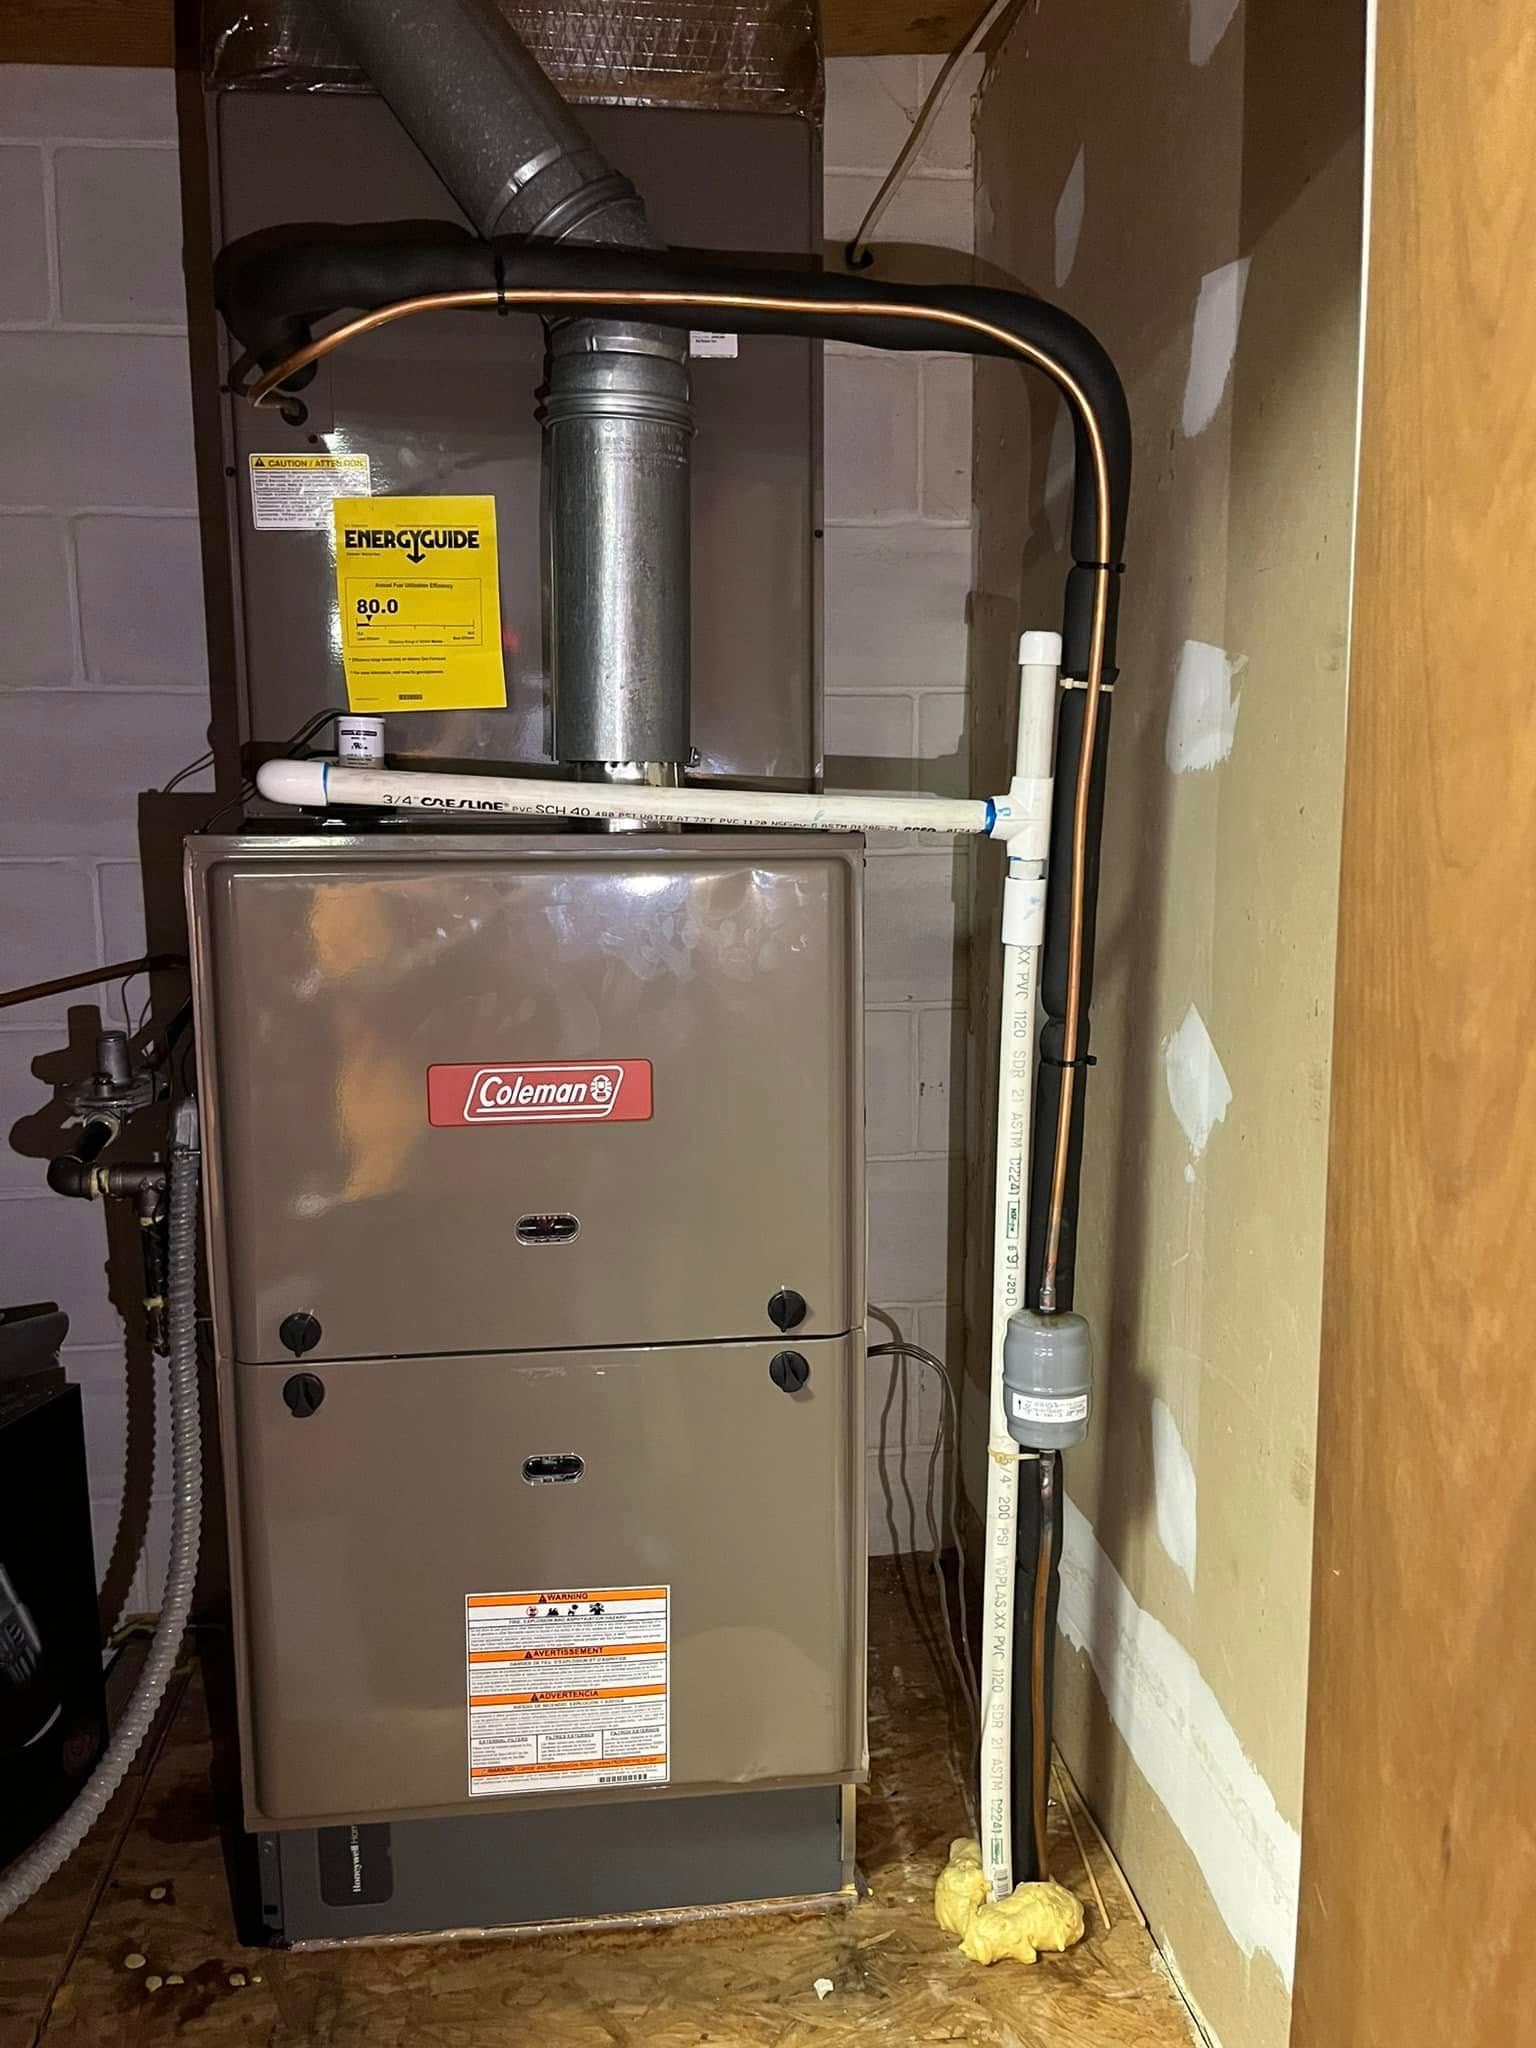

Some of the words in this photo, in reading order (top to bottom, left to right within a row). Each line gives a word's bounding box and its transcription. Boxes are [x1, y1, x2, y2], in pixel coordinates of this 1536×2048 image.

[268, 460, 307, 468] CAUTION
[344, 530, 479, 556] ENERGYGUIDE
[356, 599, 399, 614] 80.0
[535, 804, 566, 815] SCH
[569, 807, 591, 817] 40
[1015, 972, 1030, 1000] PVC
[1013, 1009, 1028, 1039] 1120
[1010, 1050, 1026, 1079] SDR
[478, 1076, 588, 1108] Coleman
[1010, 1088, 1025, 1104] 21
[1009, 1112, 1024, 1148] ASTM
[997, 1495, 1011, 1521] 200
[996, 1527, 1009, 1547] PSI
[547, 1592, 589, 1601] WARNING
[533, 1647, 604, 1657] AVERTISSEMENT
[992, 1631, 1007, 1660] PVC
[991, 1668, 1005, 1693] 1120
[539, 1690, 599, 1700] ADVERTENCIA
[991, 1704, 1005, 1729] SDR
[991, 1758, 1004, 1791] ASTM
[350, 1845, 362, 1892] Honeywell
